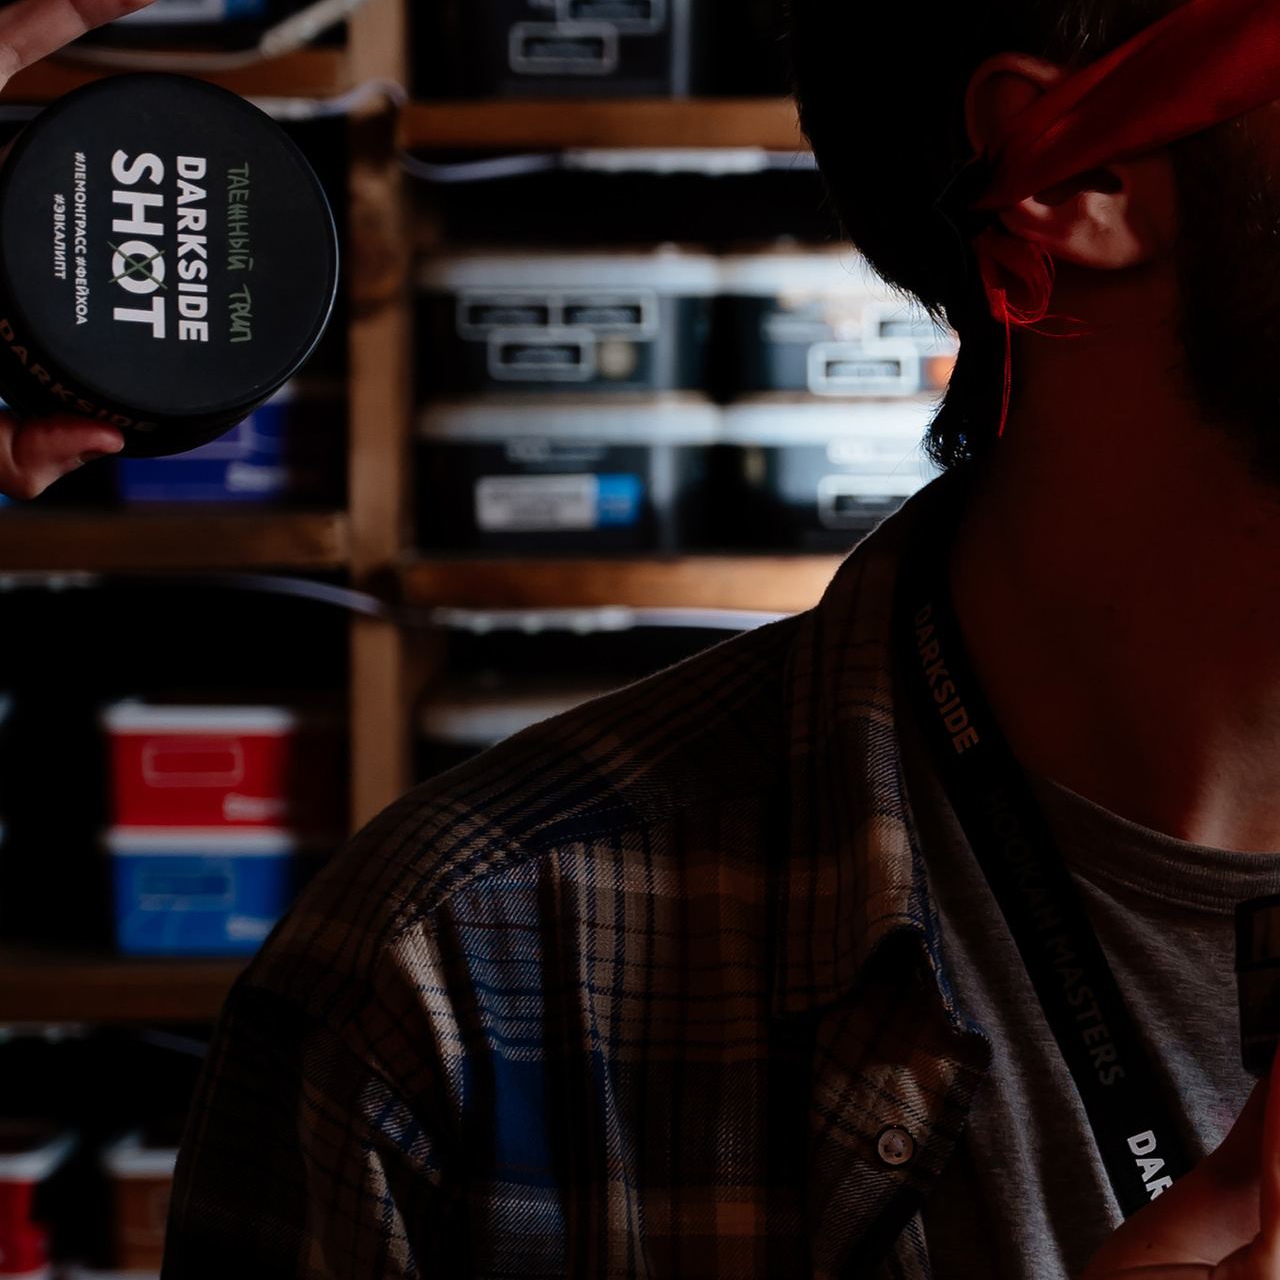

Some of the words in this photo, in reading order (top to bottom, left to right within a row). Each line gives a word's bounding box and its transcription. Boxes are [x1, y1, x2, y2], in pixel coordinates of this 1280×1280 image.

[53, 193, 67, 279] #ЭВКАЛИПТ
[74, 152, 87, 254] #ЛЕМОНГРАСС
[110, 149, 166, 339] SHOT
[176, 155, 208, 342] DARKSIDE
[226, 162, 253, 271] ТАЕЖНЫЙ
[75, 256, 90, 325] #ФЕЙХОА
[228, 283, 253, 342] ТРИП
[0, 316, 159, 432] DARKSIDE
[912, 601, 981, 755] DARKSIDE
[982, 786, 1066, 933] HOOKAH
[1045, 935, 1126, 1087] MASTERS
